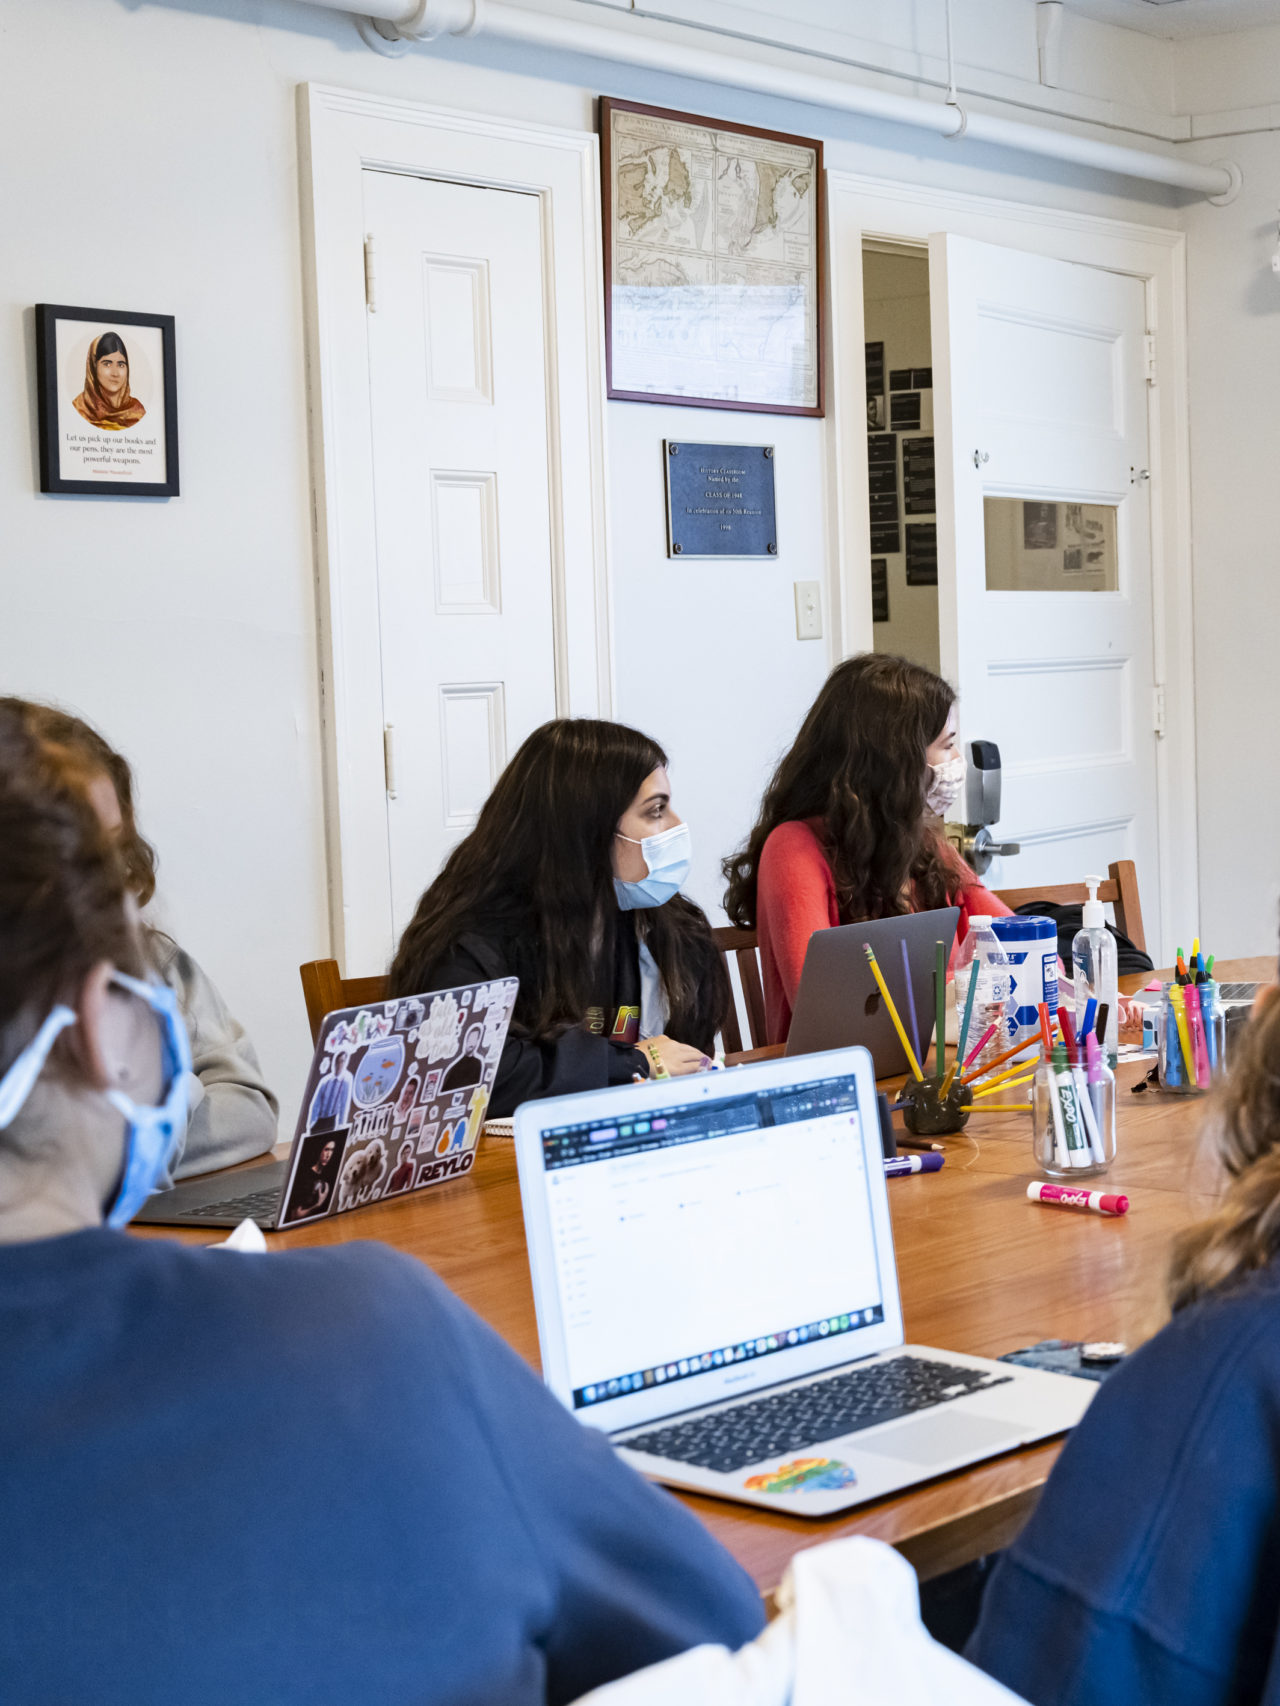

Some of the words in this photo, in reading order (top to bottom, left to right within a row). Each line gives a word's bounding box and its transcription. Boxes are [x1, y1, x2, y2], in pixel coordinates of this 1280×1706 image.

[66, 433, 77, 442] Let
[88, 434, 101, 444] pick
[124, 436, 144, 445] books
[145, 438, 157, 446] and
[100, 445, 114, 455] they
[83, 455, 111, 465] powerful
[1060, 1089, 1077, 1123] EXPO
[418, 1153, 474, 1184] REYLO
[1060, 1192, 1088, 1207] EXPO
